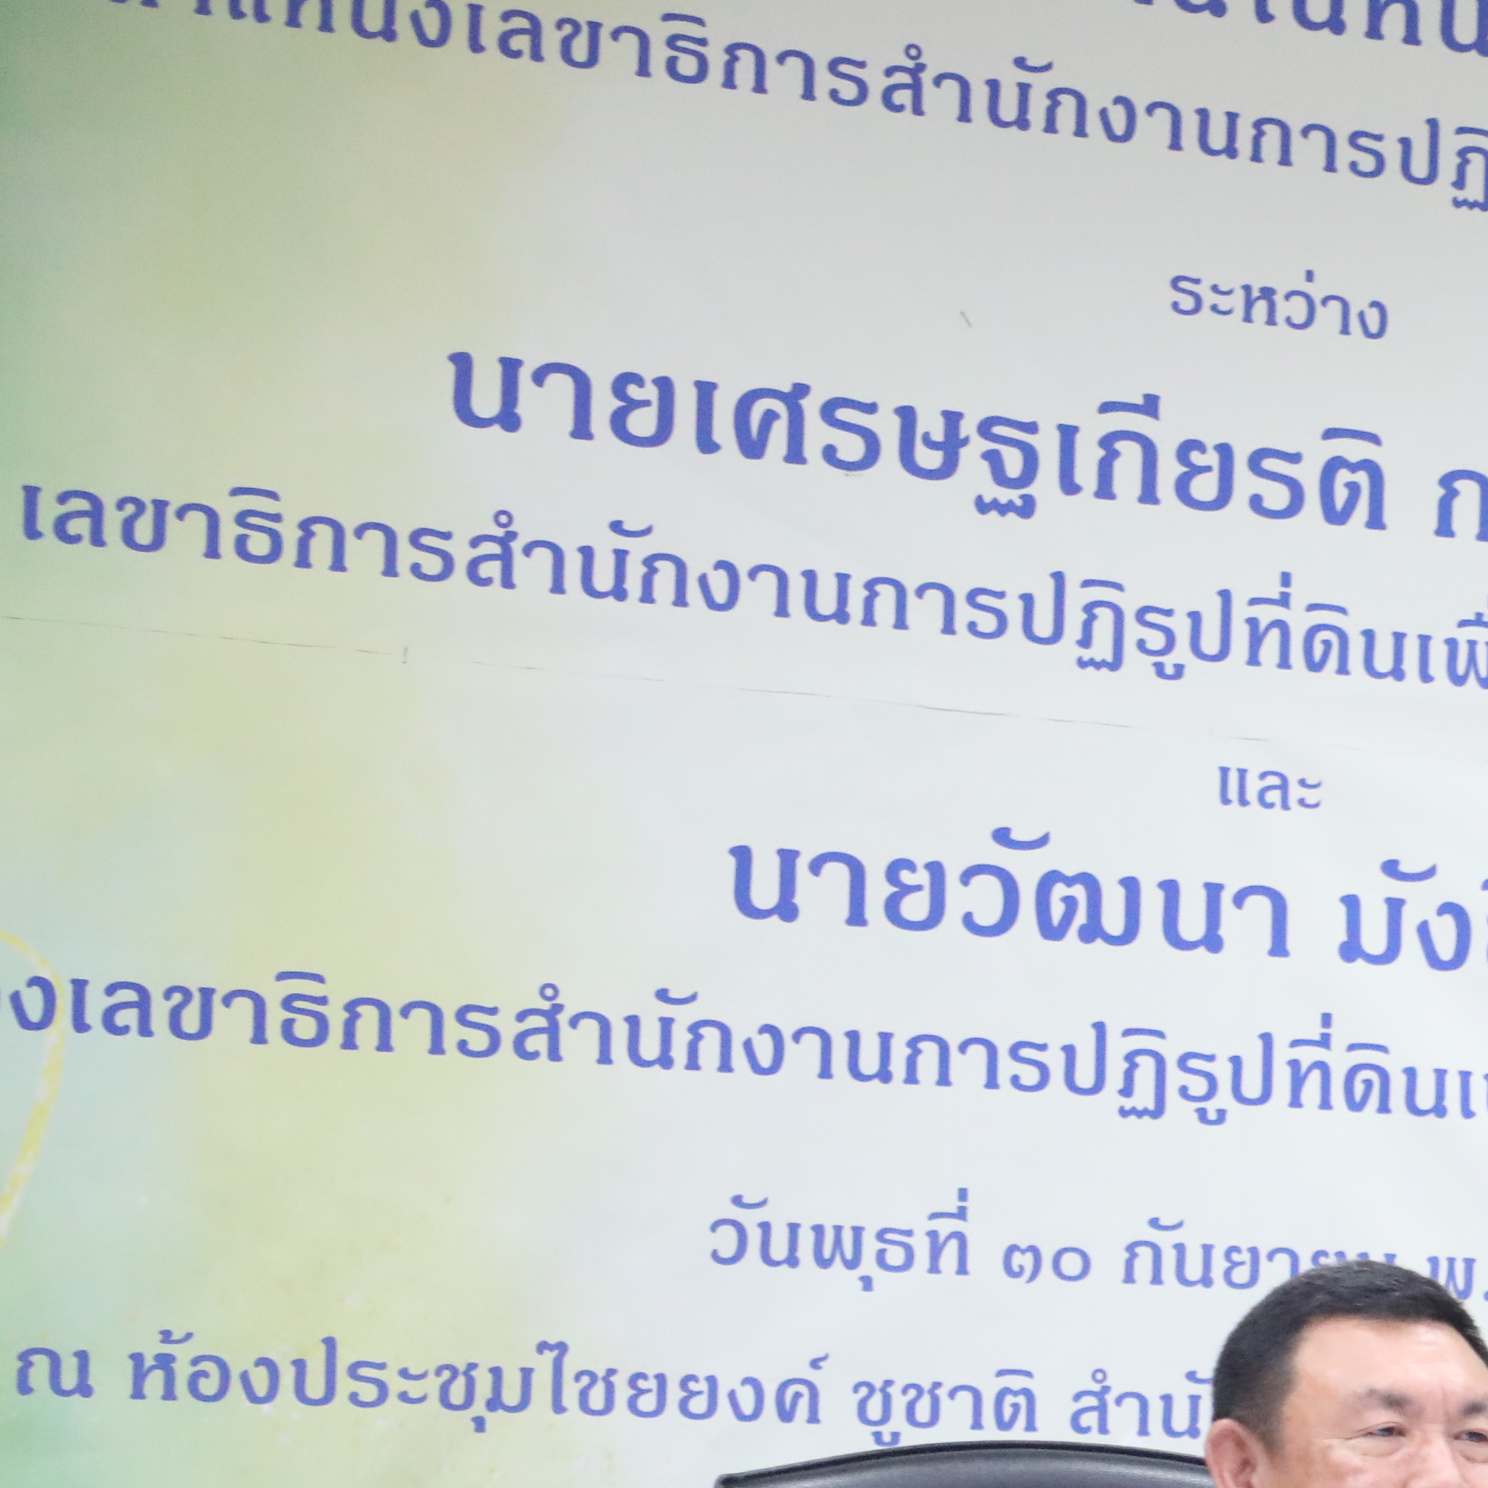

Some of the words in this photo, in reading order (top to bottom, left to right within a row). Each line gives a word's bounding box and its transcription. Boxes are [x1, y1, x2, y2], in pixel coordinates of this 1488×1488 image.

[1169, 269, 1389, 339] ระหว่าง
[448, 352, 1388, 531] นายเศรษฐเกียรติ
[1218, 766, 1323, 811] และ
[727, 826, 1291, 958] นายวัฒนา
[709, 1187, 970, 1292] วันพุธที่
[1002, 1243, 1092, 1284] ๓๐
[17, 1347, 95, 1398] ณ
[129, 1329, 830, 1433] ห้องประชุมไชยยงค์
[852, 1368, 1037, 1436] ชูชาติ
